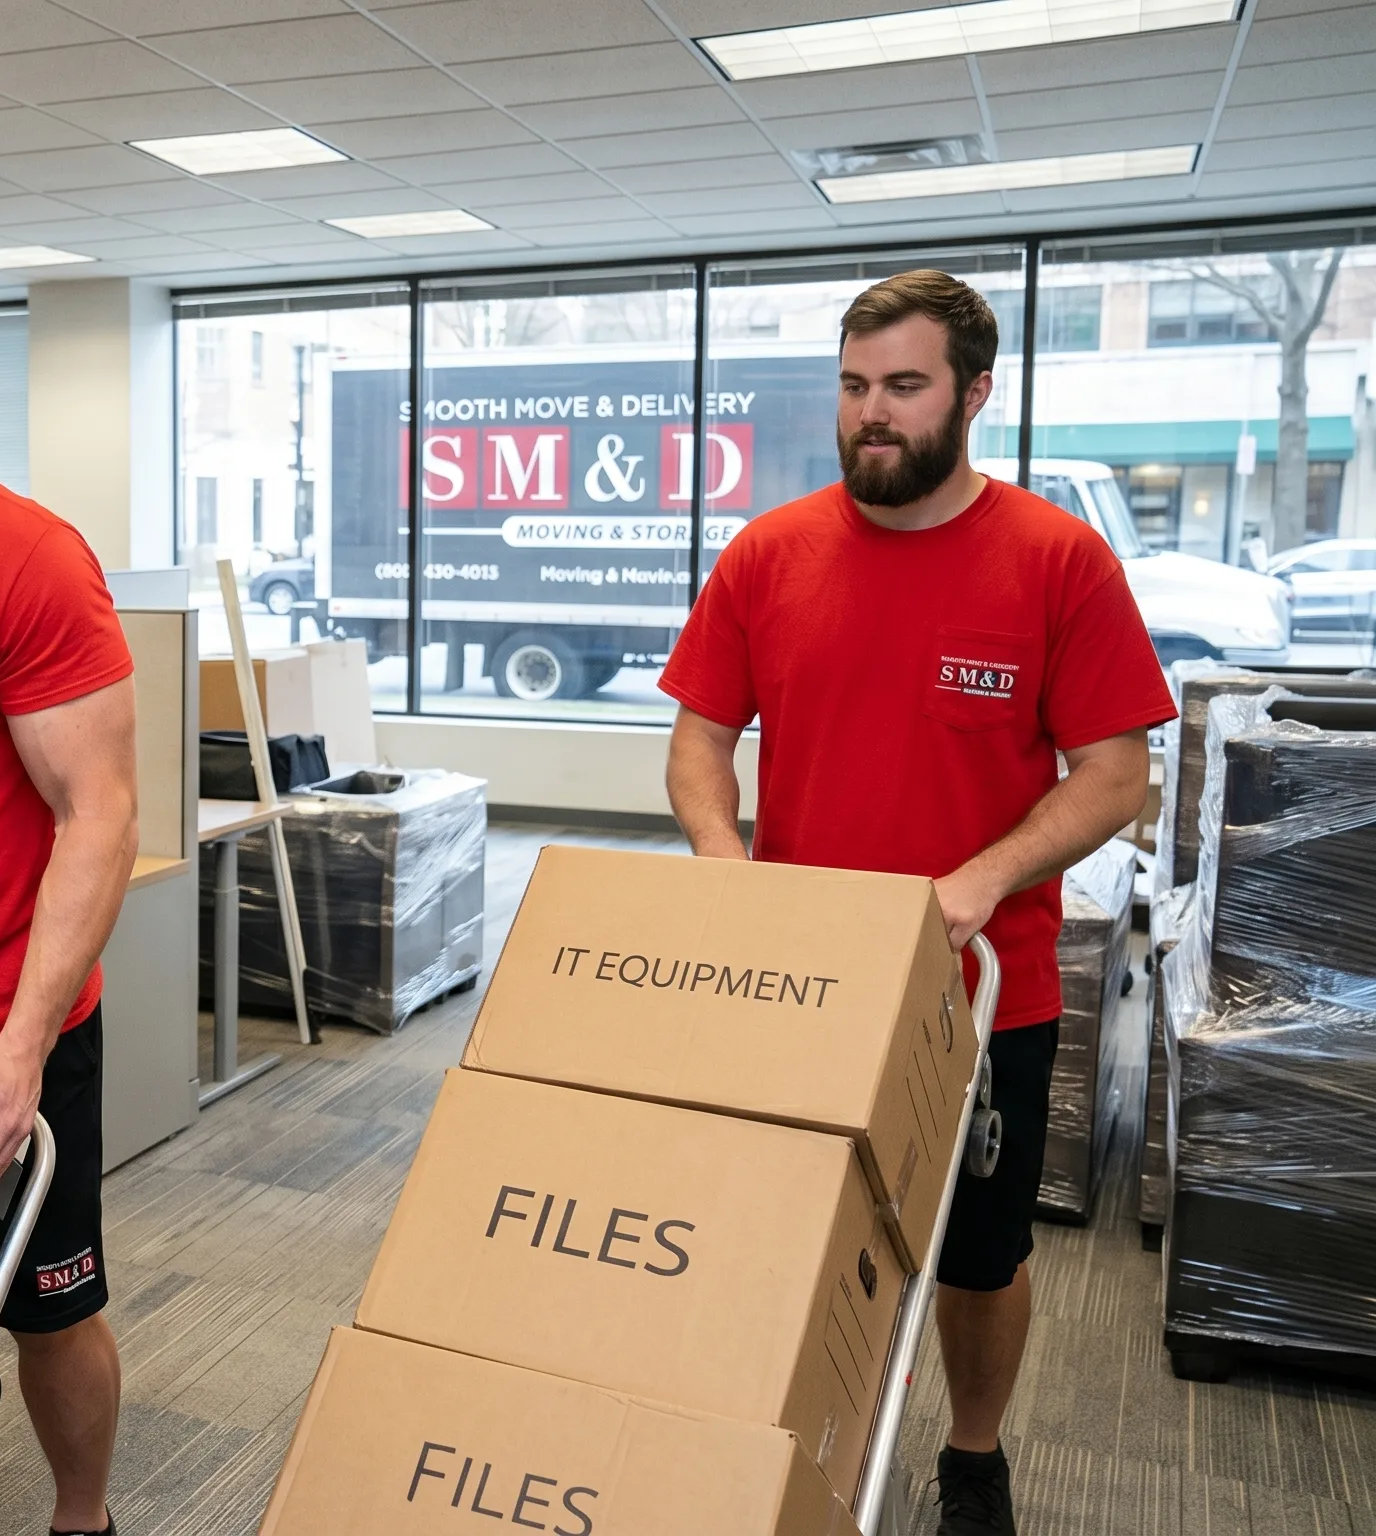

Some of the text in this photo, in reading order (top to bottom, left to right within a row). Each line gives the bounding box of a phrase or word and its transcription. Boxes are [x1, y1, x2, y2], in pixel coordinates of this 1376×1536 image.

[514, 396, 590, 419] MOVE
[595, 395, 615, 418] &
[621, 391, 756, 417] DELIVERY
[516, 524, 734, 542] MOVING & STORGE
[552, 946, 839, 1008] IT EQUIPMENT
[485, 1185, 696, 1277] FILES
[407, 1441, 599, 1536] FILES
